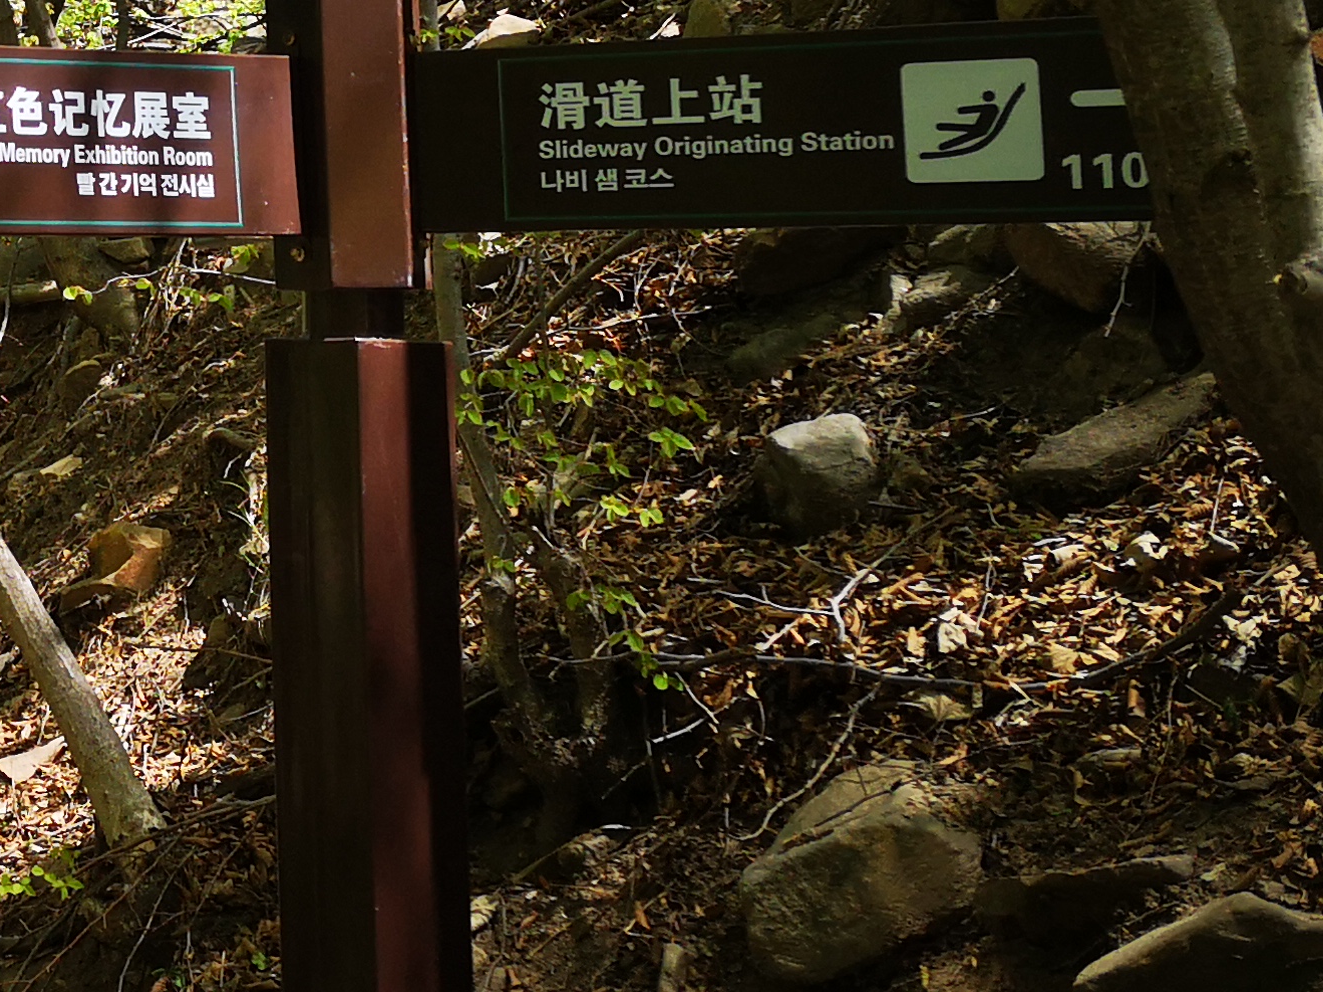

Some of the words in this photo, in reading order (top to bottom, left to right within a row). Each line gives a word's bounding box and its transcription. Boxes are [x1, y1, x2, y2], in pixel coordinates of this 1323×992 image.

[539, 74, 763, 129] 滑道上站
[74, 144, 159, 166] Exhibition
[163, 147, 214, 166] Room
[539, 139, 648, 160] Slideway
[654, 134, 794, 159] Originating
[801, 130, 895, 152] Station
[160, 174, 215, 198] 전시실
[541, 169, 588, 192] 나비
[595, 168, 619, 191] 샘
[623, 168, 674, 189] 코스
